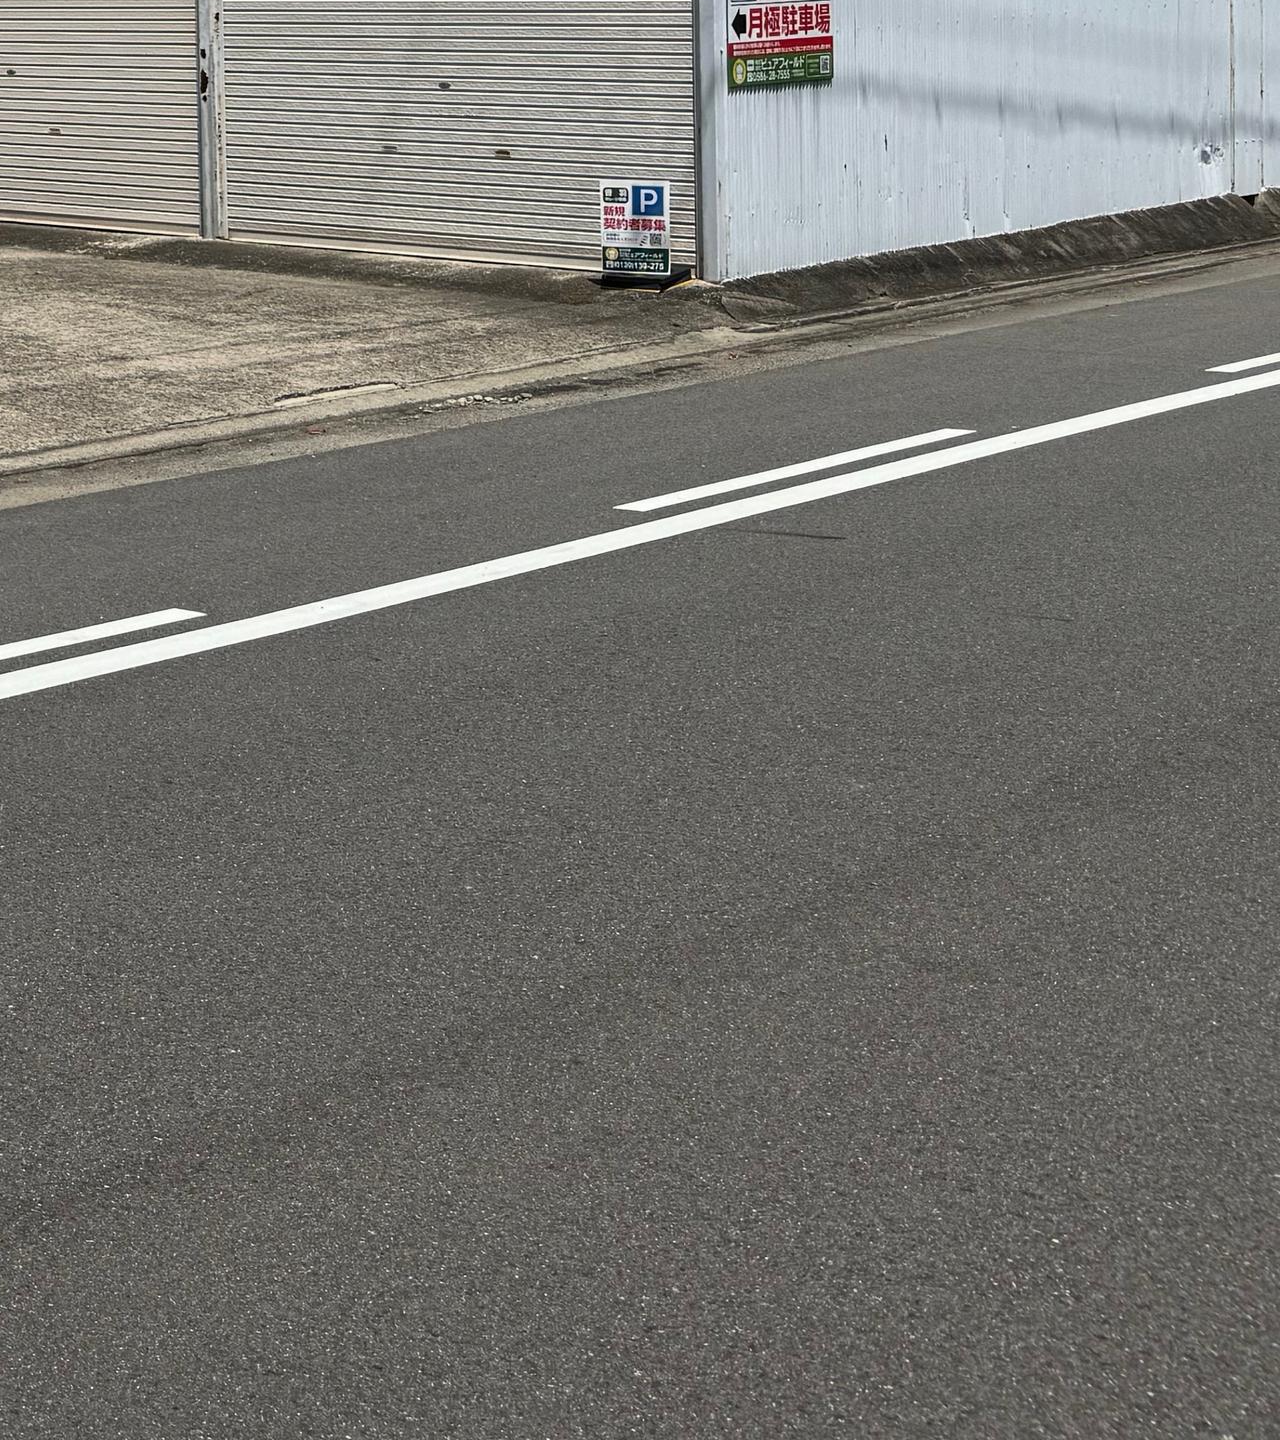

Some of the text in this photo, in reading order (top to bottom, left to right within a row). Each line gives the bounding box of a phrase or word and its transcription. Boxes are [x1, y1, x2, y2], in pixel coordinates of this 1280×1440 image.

[748, 3, 831, 39] 月極駐車場
[640, 188, 658, 213] P
[603, 206, 625, 216] 新規
[603, 218, 666, 231] 契約者募集
